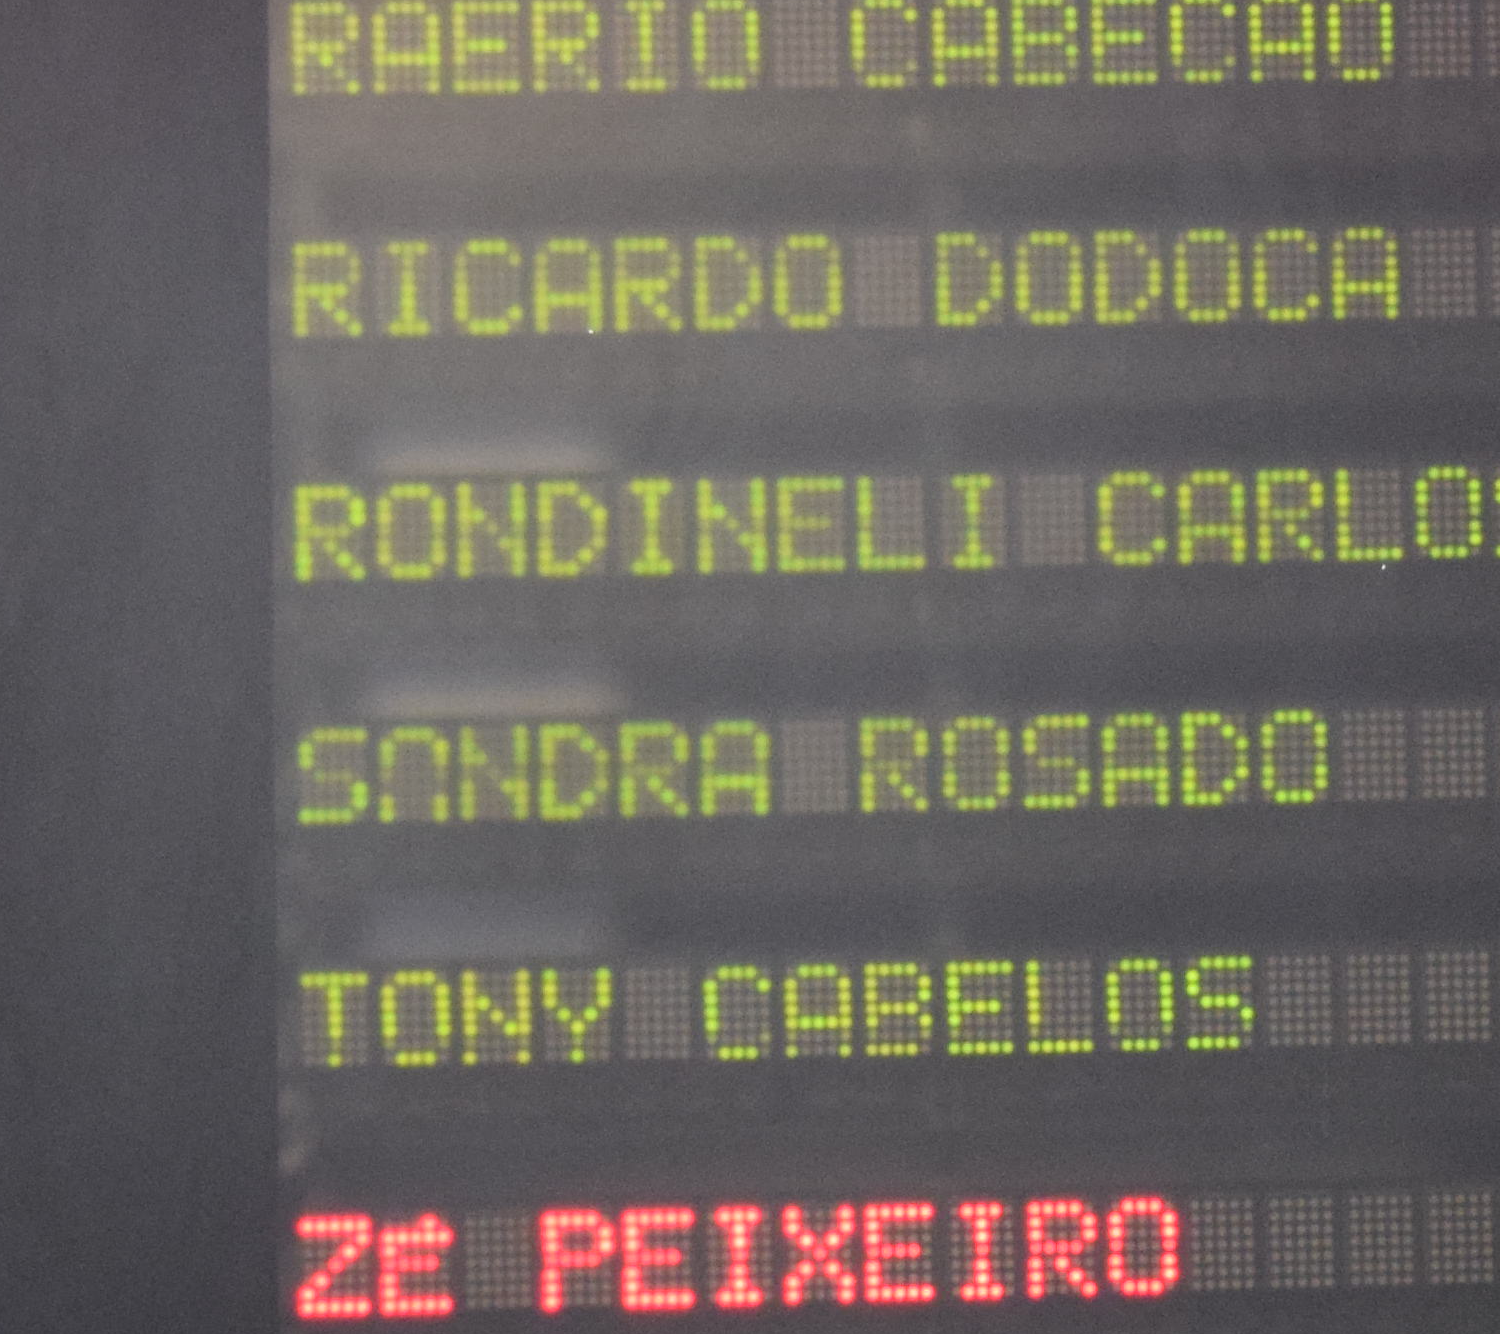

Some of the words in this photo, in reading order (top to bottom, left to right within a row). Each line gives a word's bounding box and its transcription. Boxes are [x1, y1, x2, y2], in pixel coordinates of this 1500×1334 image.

[292, 234, 843, 336] RICARDO
[935, 227, 1400, 327] DODOCA
[294, 474, 994, 582] RONDINELI
[860, 709, 1329, 812] ROSADO
[301, 967, 612, 1067] TONY
[702, 955, 1256, 1060] CABELOS
[536, 1194, 1182, 1316] PEIXEIRO
